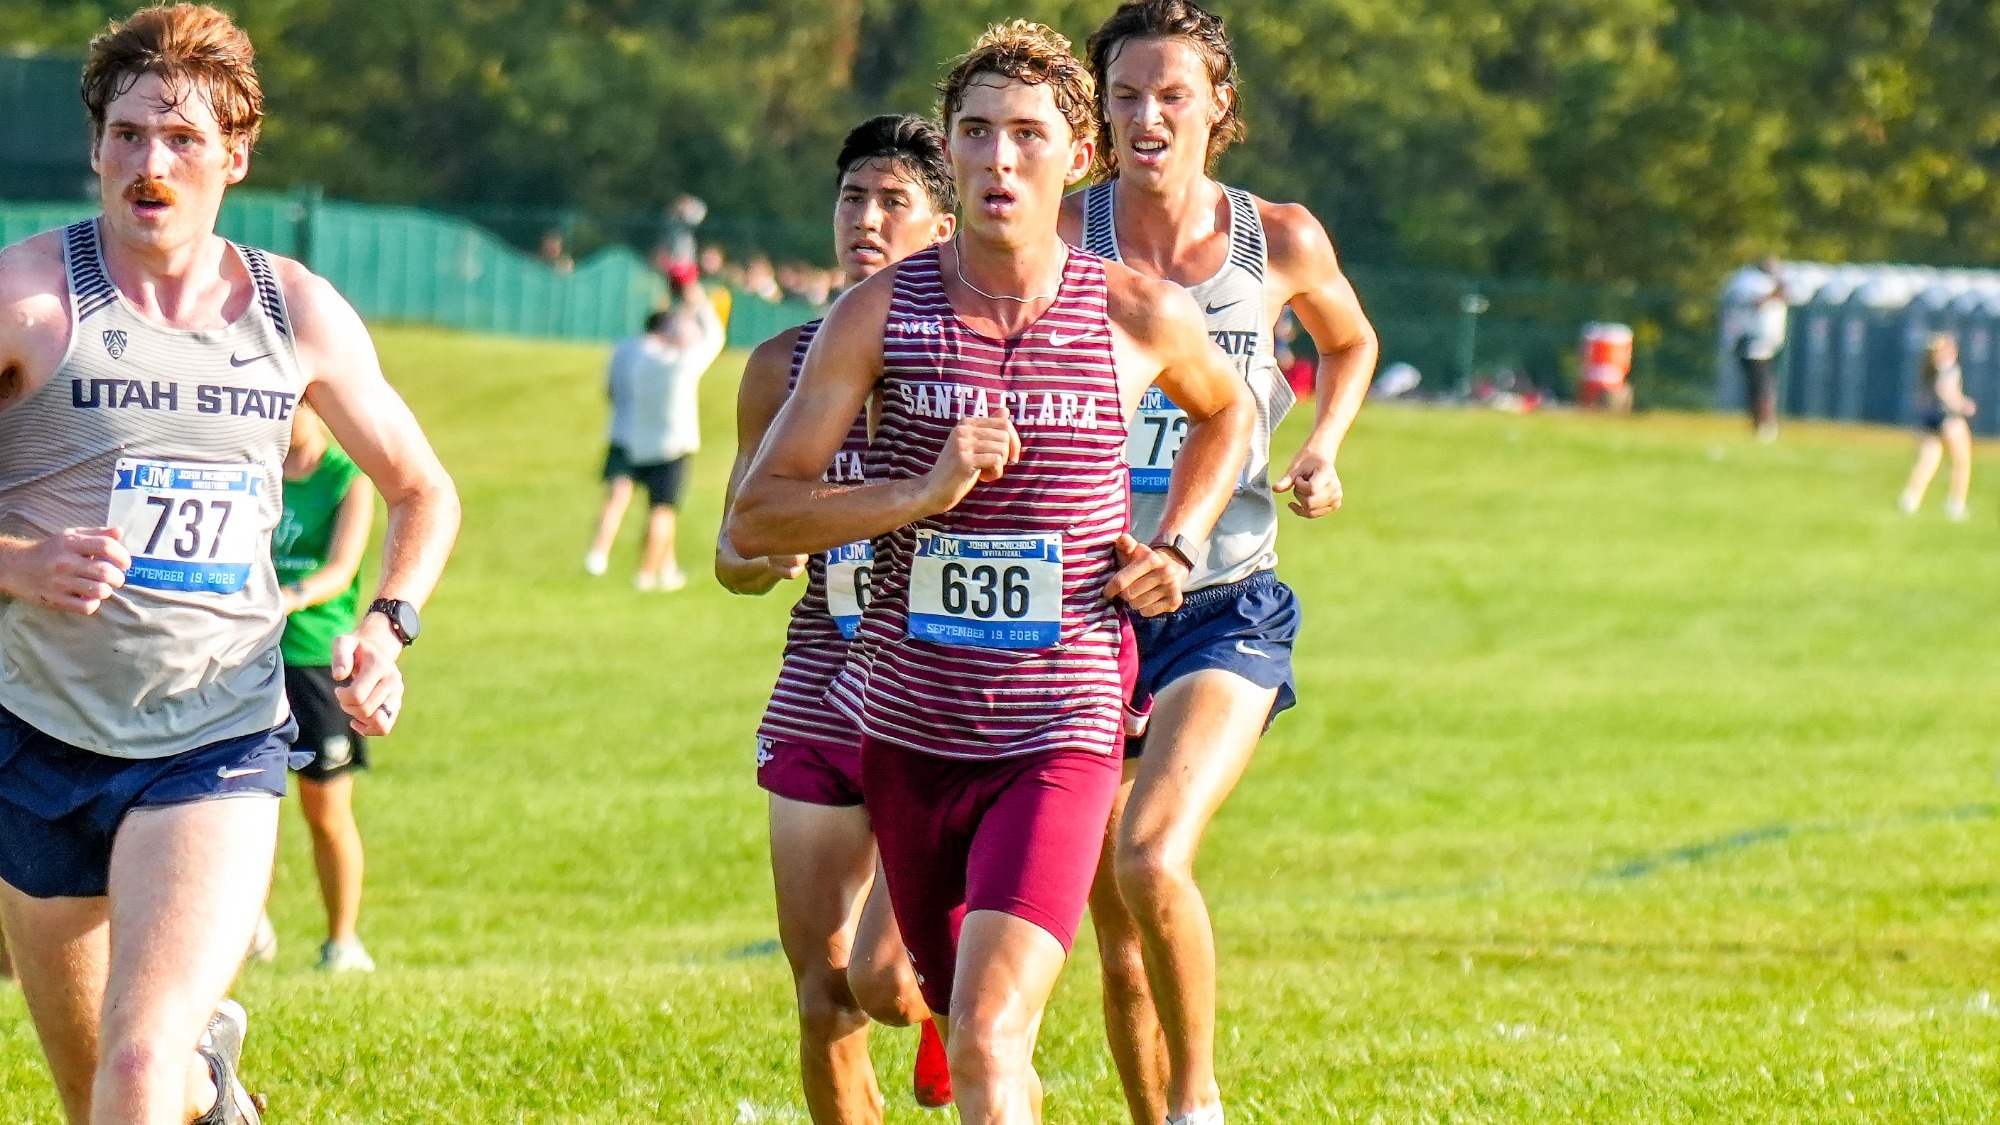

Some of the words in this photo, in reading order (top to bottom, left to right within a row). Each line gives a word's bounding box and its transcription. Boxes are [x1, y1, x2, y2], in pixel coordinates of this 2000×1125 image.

[1208, 331, 1258, 356] ATE
[72, 378, 178, 411] UTAH
[197, 384, 296, 421] STATE
[900, 383, 989, 420] SANTA
[1000, 390, 1098, 430] CLARA
[1144, 416, 1188, 466] 73
[141, 466, 172, 488] JM
[1131, 476, 1170, 486] SEPTEM
[143, 496, 232, 559] 737
[845, 544, 867, 560] JM
[937, 536, 960, 555] JM
[967, 540, 990, 549] JOHN
[126, 567, 185, 583] EPTEMBER
[208, 573, 236, 585] 2026
[942, 562, 1030, 619] 636
[926, 623, 984, 639] SEPTEMBER
[1009, 630, 1039, 641] 2026
